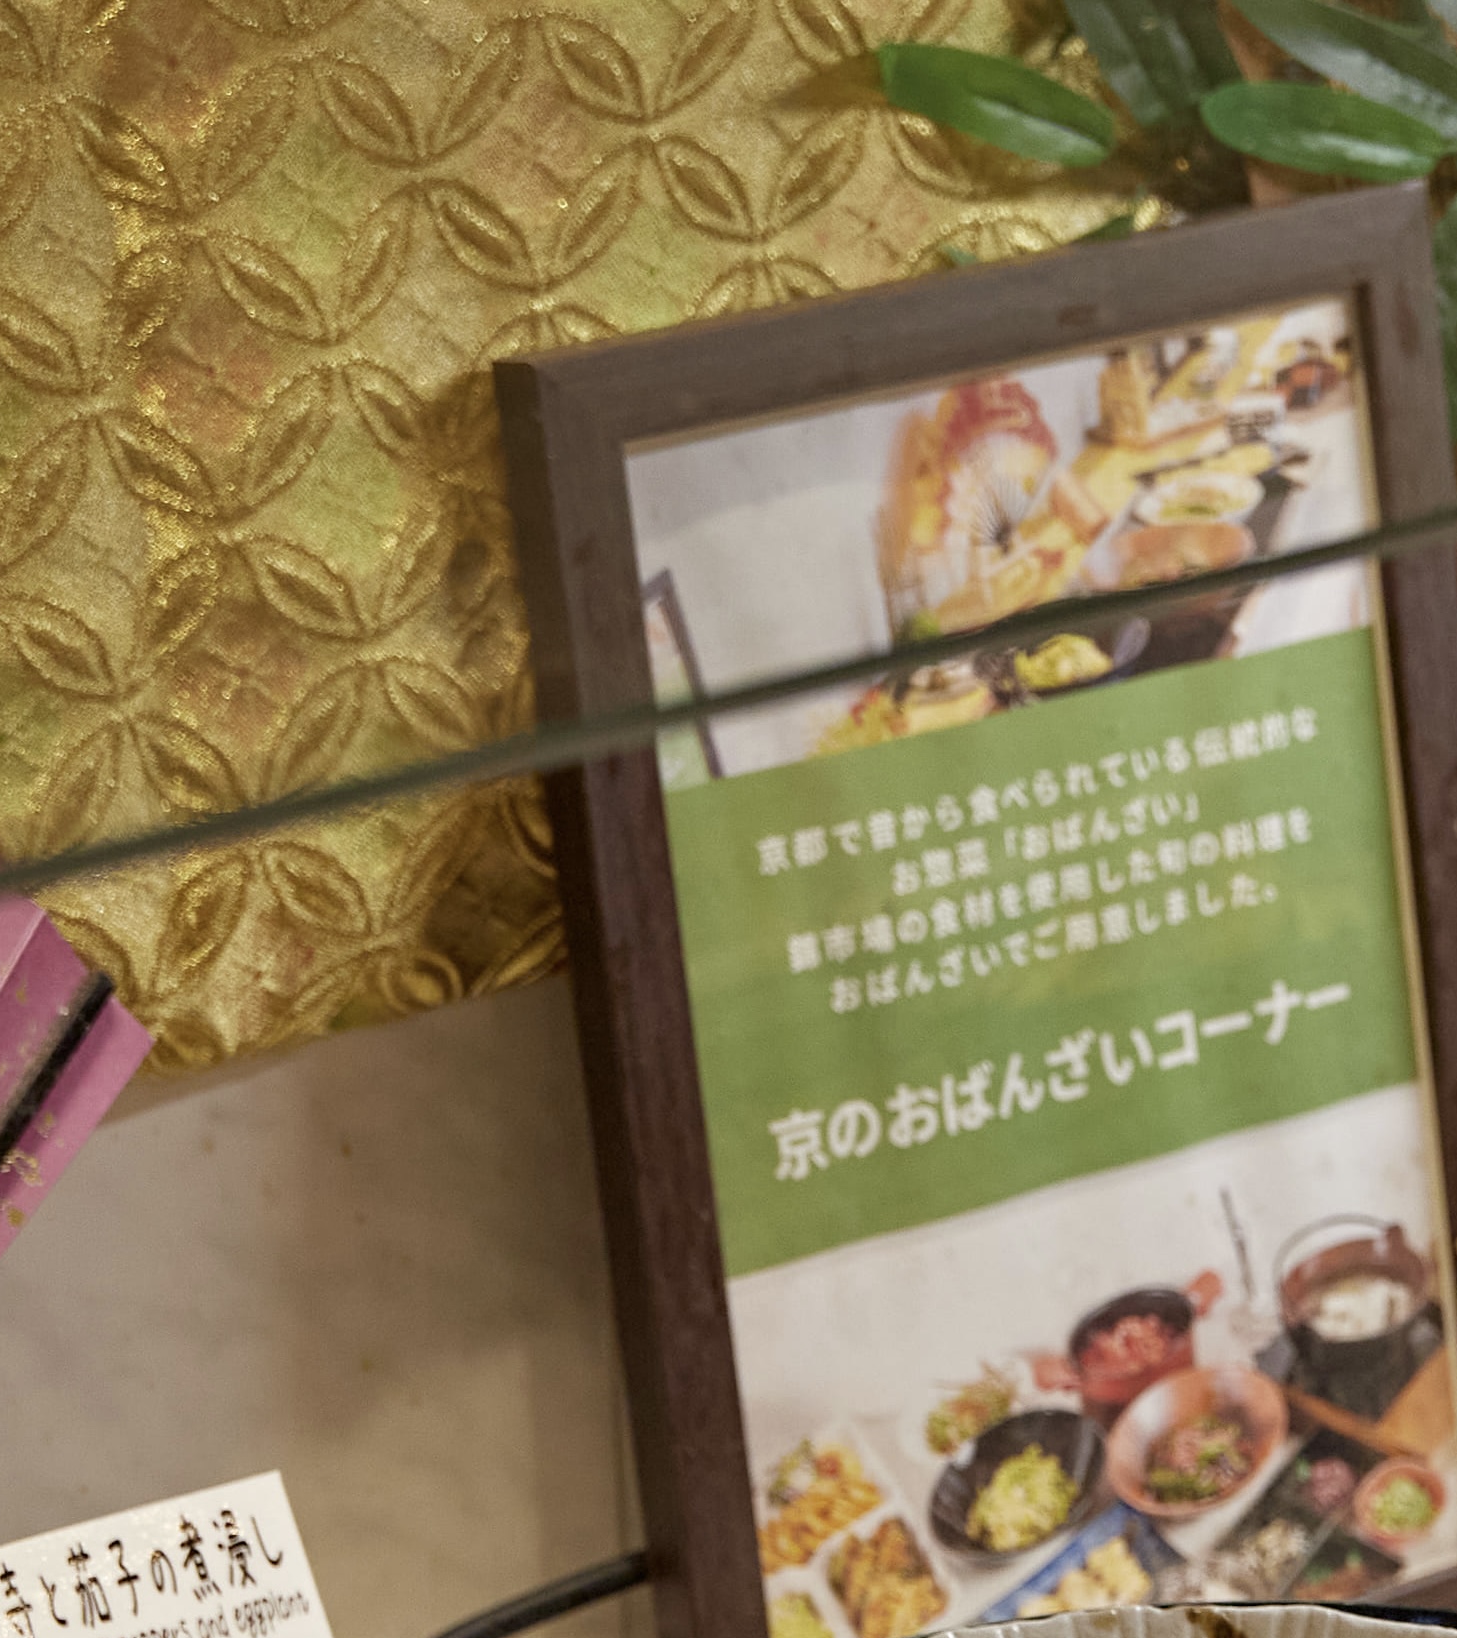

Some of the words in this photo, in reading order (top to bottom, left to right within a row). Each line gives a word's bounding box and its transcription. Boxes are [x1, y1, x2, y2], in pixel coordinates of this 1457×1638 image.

[767, 978, 1352, 1182] 京のおばんざいコーナー
